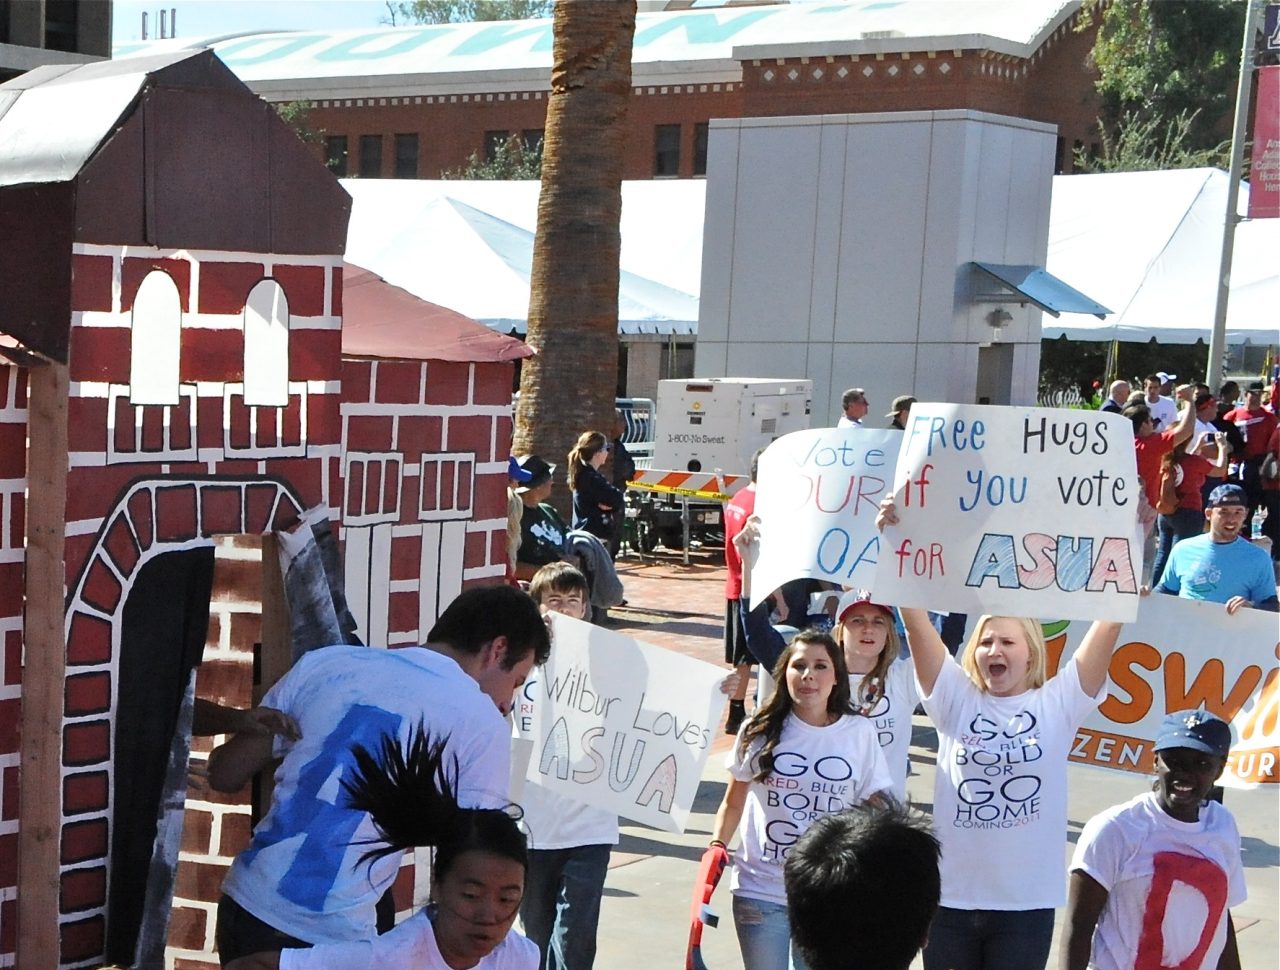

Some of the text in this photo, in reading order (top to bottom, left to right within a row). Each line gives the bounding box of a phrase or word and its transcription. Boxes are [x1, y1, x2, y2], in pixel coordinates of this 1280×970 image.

[904, 464, 1128, 511] if you vote
[965, 532, 1138, 595] ASUA
[543, 664, 622, 719] Wilbur
[632, 692, 710, 750] Loves
[538, 716, 678, 814] ASUA
[771, 751, 853, 782] GO
[955, 743, 1043, 766] BOLD
[984, 765, 1014, 777] OR
[767, 790, 845, 813] BOLD
[810, 781, 849, 796] BLUE
[957, 775, 1042, 806] GO
[956, 796, 1041, 821] HOME
